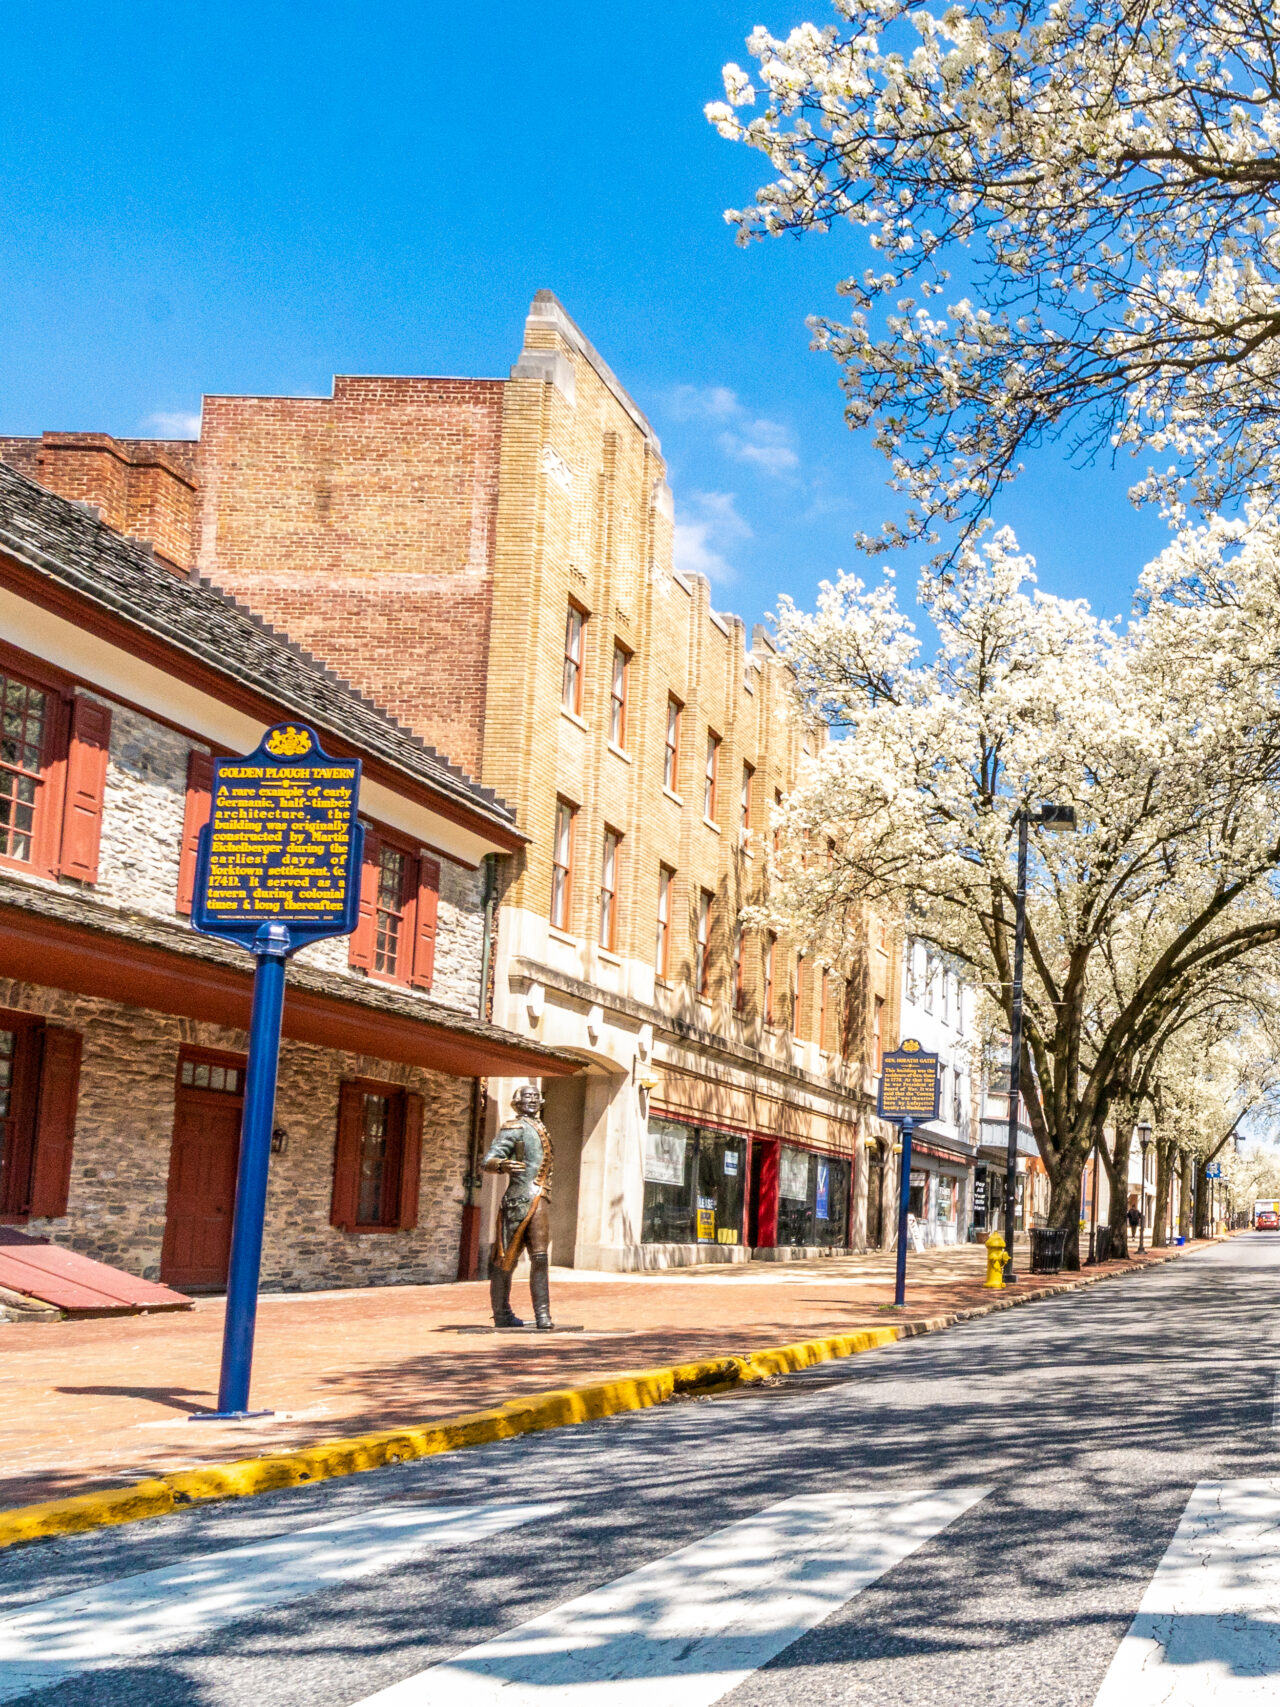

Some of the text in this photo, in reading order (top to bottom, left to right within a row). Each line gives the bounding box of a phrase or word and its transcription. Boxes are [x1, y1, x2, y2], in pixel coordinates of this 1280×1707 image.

[219, 768, 355, 779] GOLDEN PLOUGH TAVERN
[218, 785, 352, 799] A rare example of early
[279, 798, 351, 808] half-timber
[328, 809, 350, 819] the
[214, 820, 349, 833] building was originally
[213, 831, 349, 844] constructed by Martin
[212, 842, 348, 855] Eichelberger during the
[210, 854, 347, 866] earliest days of
[210, 865, 263, 875] Yorktown
[332, 866, 346, 876] (c.
[249, 876, 259, 886] It
[267, 877, 309, 887] served
[317, 879, 331, 887] as
[338, 879, 345, 887] a
[208, 888, 344, 900] tavern during colonial
[206, 899, 344, 912] times & long thereafter.
